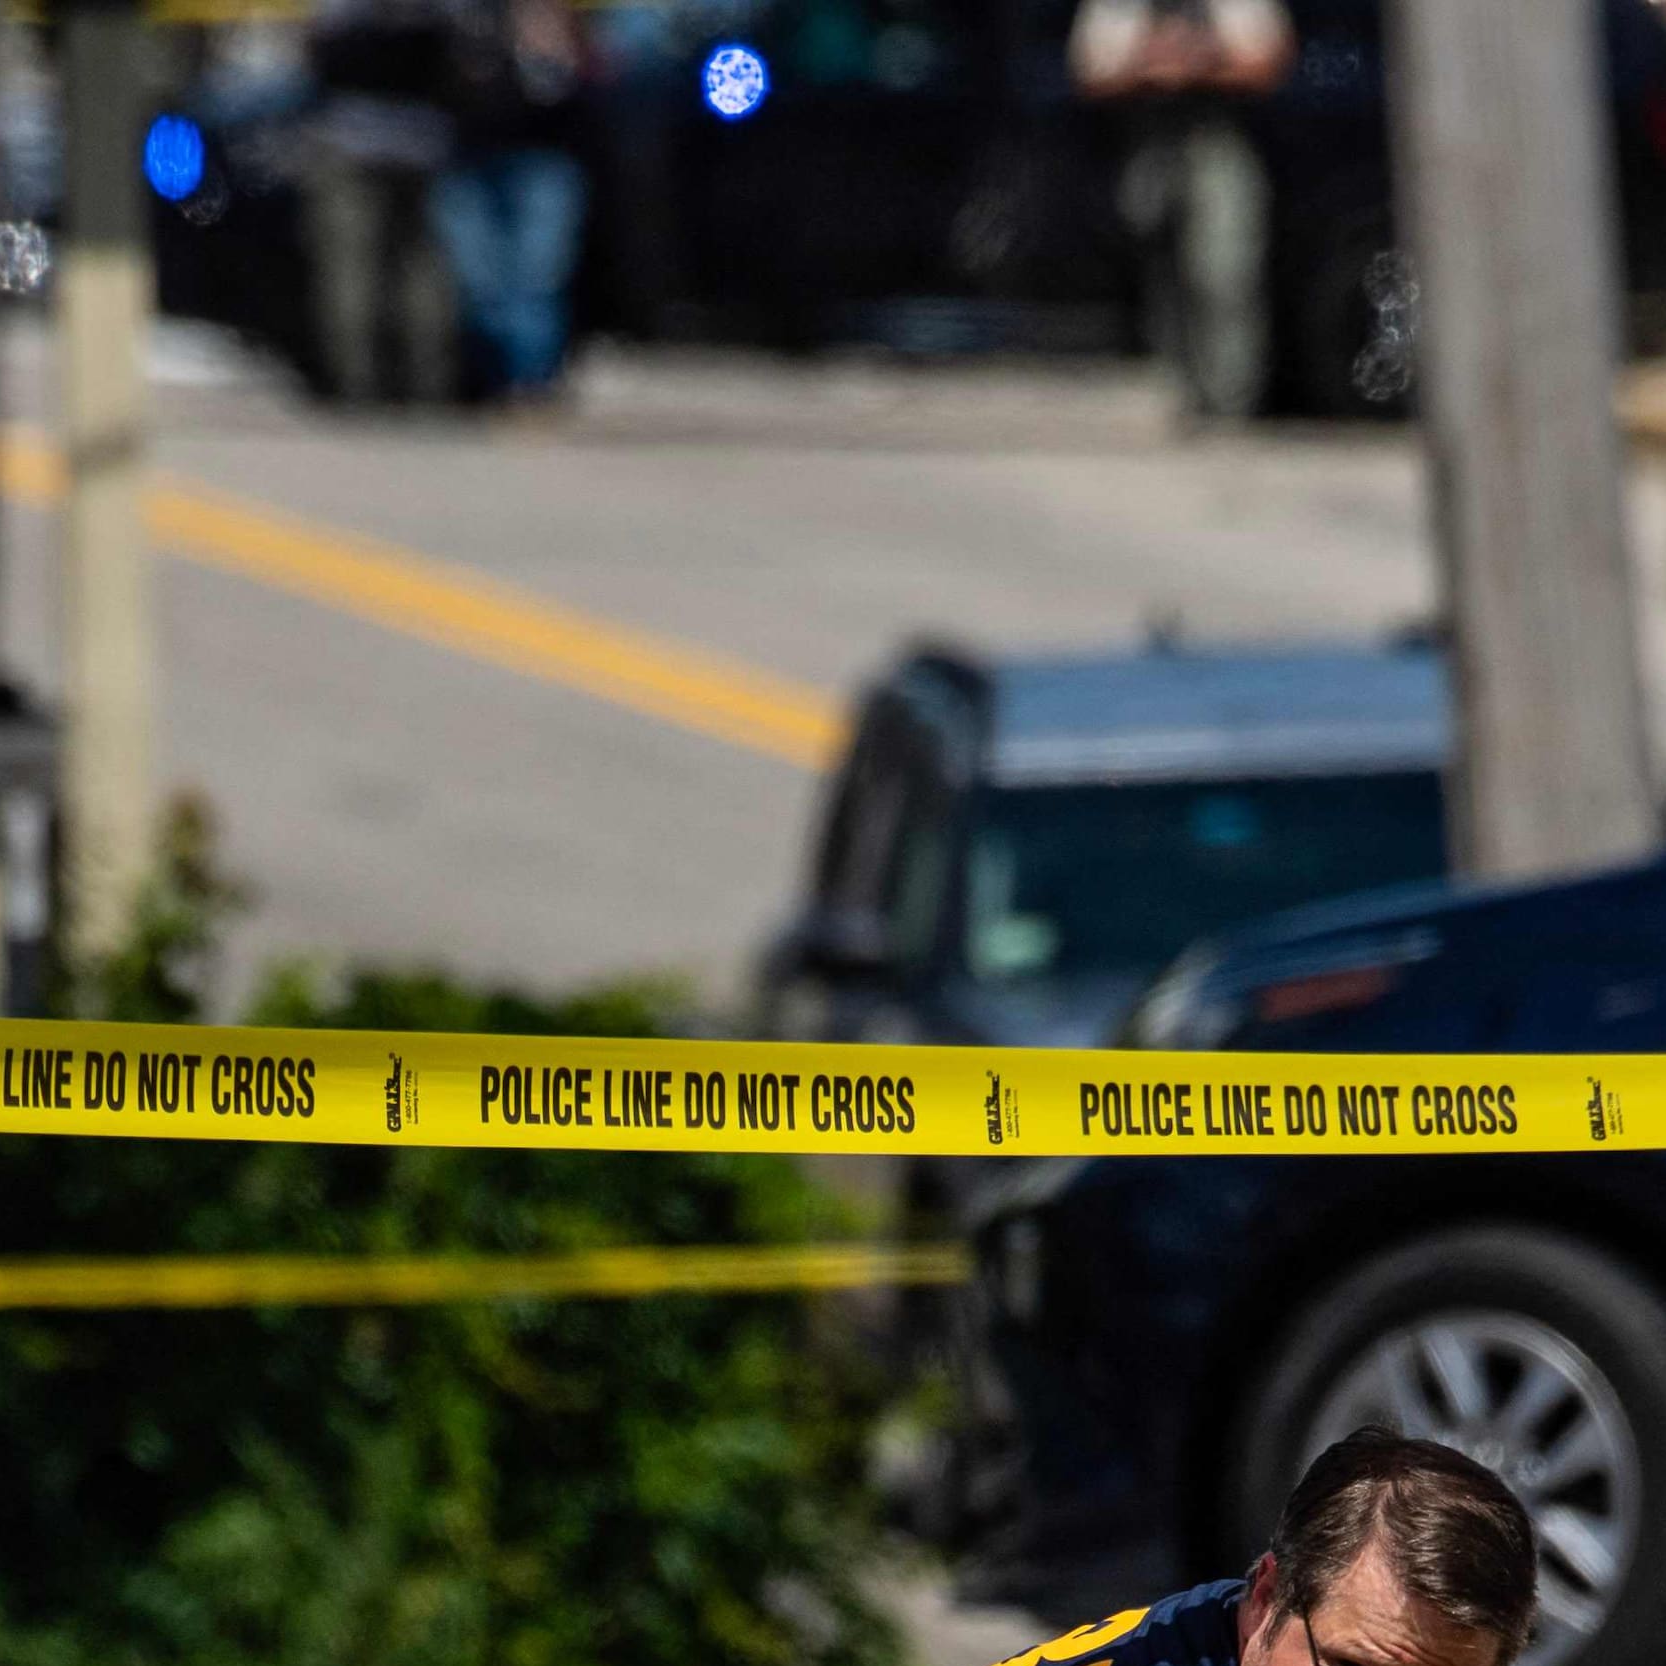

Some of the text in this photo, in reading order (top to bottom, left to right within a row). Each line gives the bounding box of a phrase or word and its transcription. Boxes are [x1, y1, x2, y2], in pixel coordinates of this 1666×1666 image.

[4, 1048, 73, 1109] LINE
[84, 1051, 126, 1111] DO
[138, 1053, 201, 1113] NOT
[212, 1055, 315, 1117] CROSS
[481, 1066, 592, 1126] POLICE
[604, 1070, 672, 1127] LINE
[685, 1072, 725, 1129] DO
[738, 1073, 800, 1131] NOT
[812, 1075, 915, 1133] CROSS
[1081, 1082, 1517, 1136] POLICE LINE DO NOT CROSS
